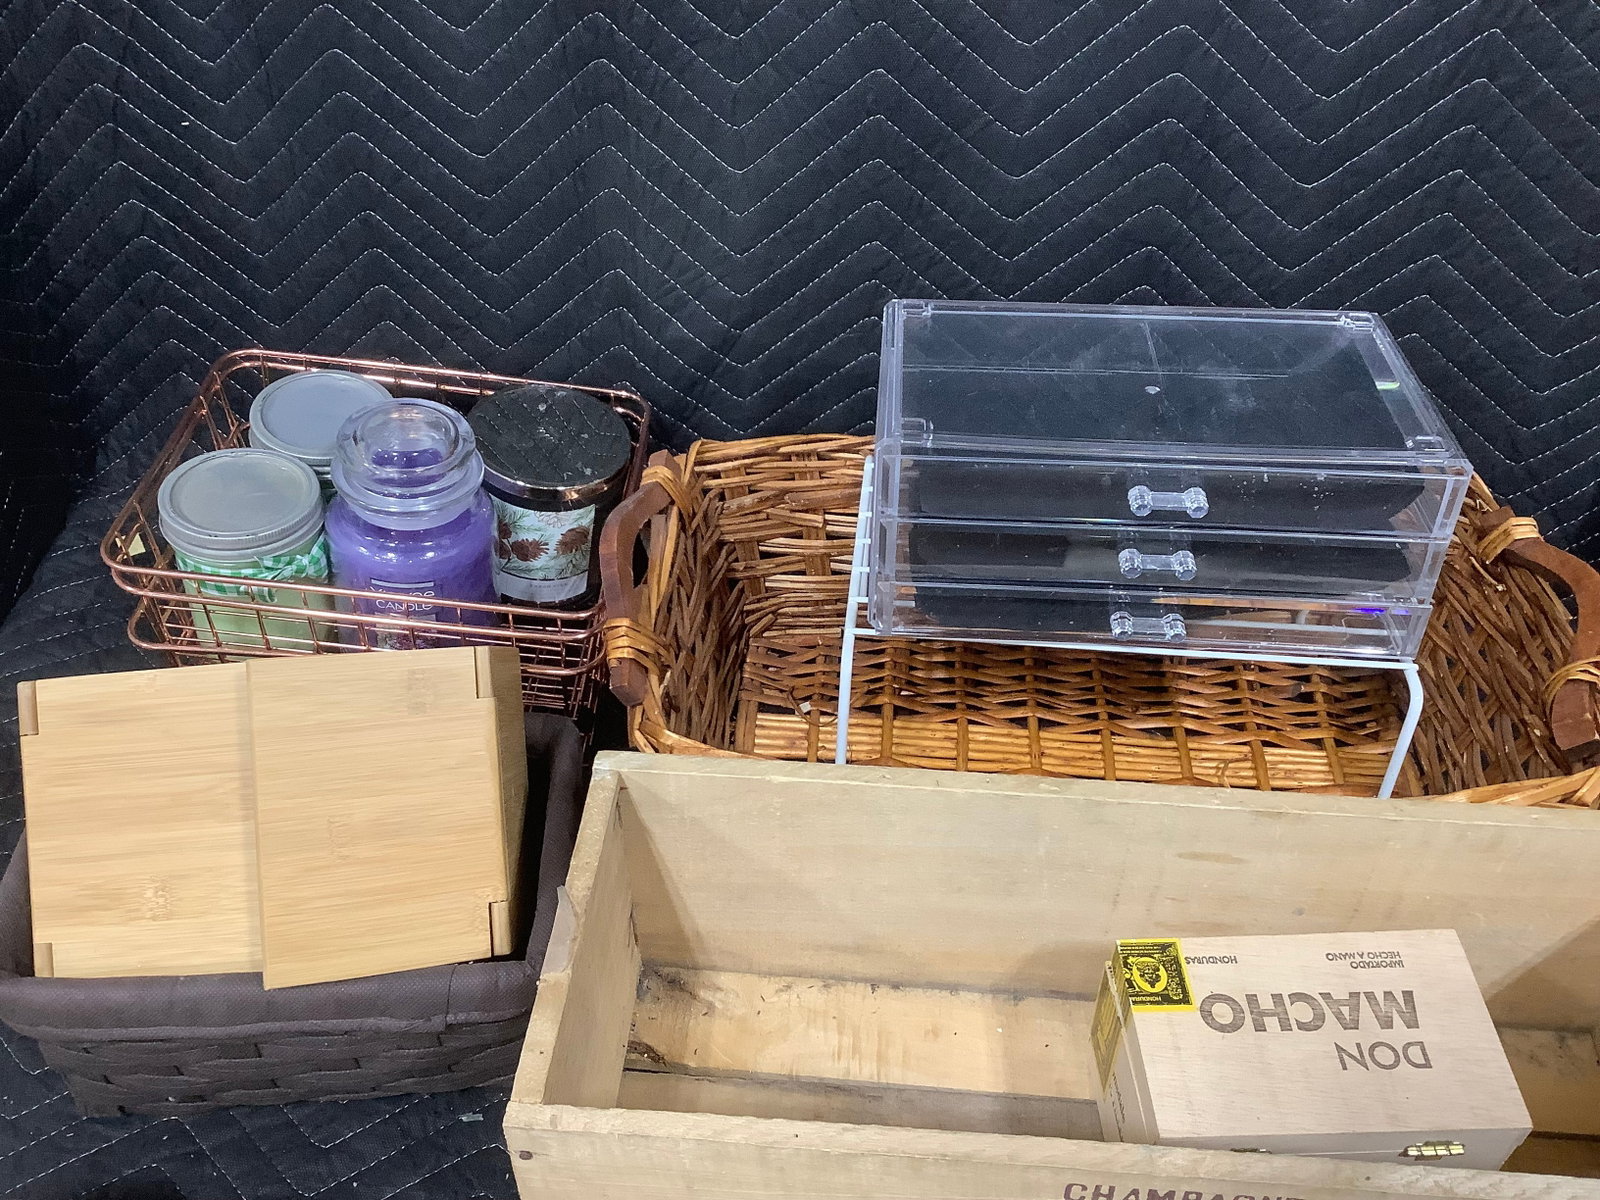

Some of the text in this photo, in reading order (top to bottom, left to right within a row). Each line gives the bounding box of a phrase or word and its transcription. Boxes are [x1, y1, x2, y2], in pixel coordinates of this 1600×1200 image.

[376, 599, 433, 611] CANDLE
[1184, 955, 1238, 965] HONDURAS
[1325, 951, 1401, 961] HECHO A MANO
[1350, 960, 1405, 970] IMPORTADO
[1199, 990, 1420, 1034] MACHO
[1334, 1042, 1433, 1072] DON
